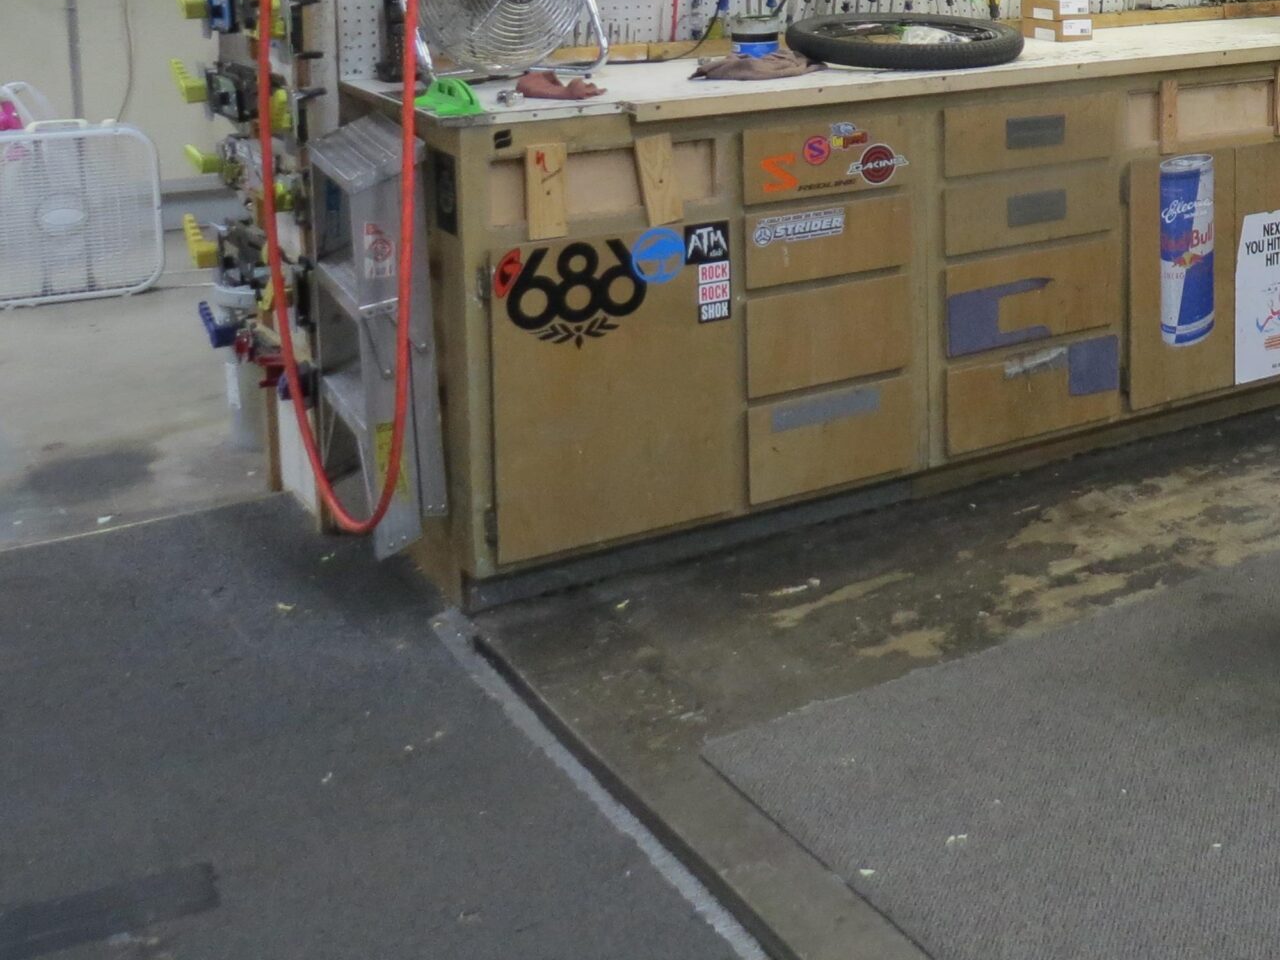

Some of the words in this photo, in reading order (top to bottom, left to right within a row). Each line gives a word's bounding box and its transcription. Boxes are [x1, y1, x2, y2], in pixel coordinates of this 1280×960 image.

[797, 178, 857, 192] REDLINE
[774, 217, 842, 238] STRIDER
[1191, 223, 1214, 248] Bull
[687, 227, 728, 259] ATM
[1245, 239, 1265, 255] YOU
[1267, 236, 1280, 251] HIT
[1265, 251, 1280, 267] HIT
[701, 263, 728, 280] ROCK
[506, 238, 648, 330] 686
[701, 283, 728, 301] ROCK
[701, 302, 728, 320] SHOX
